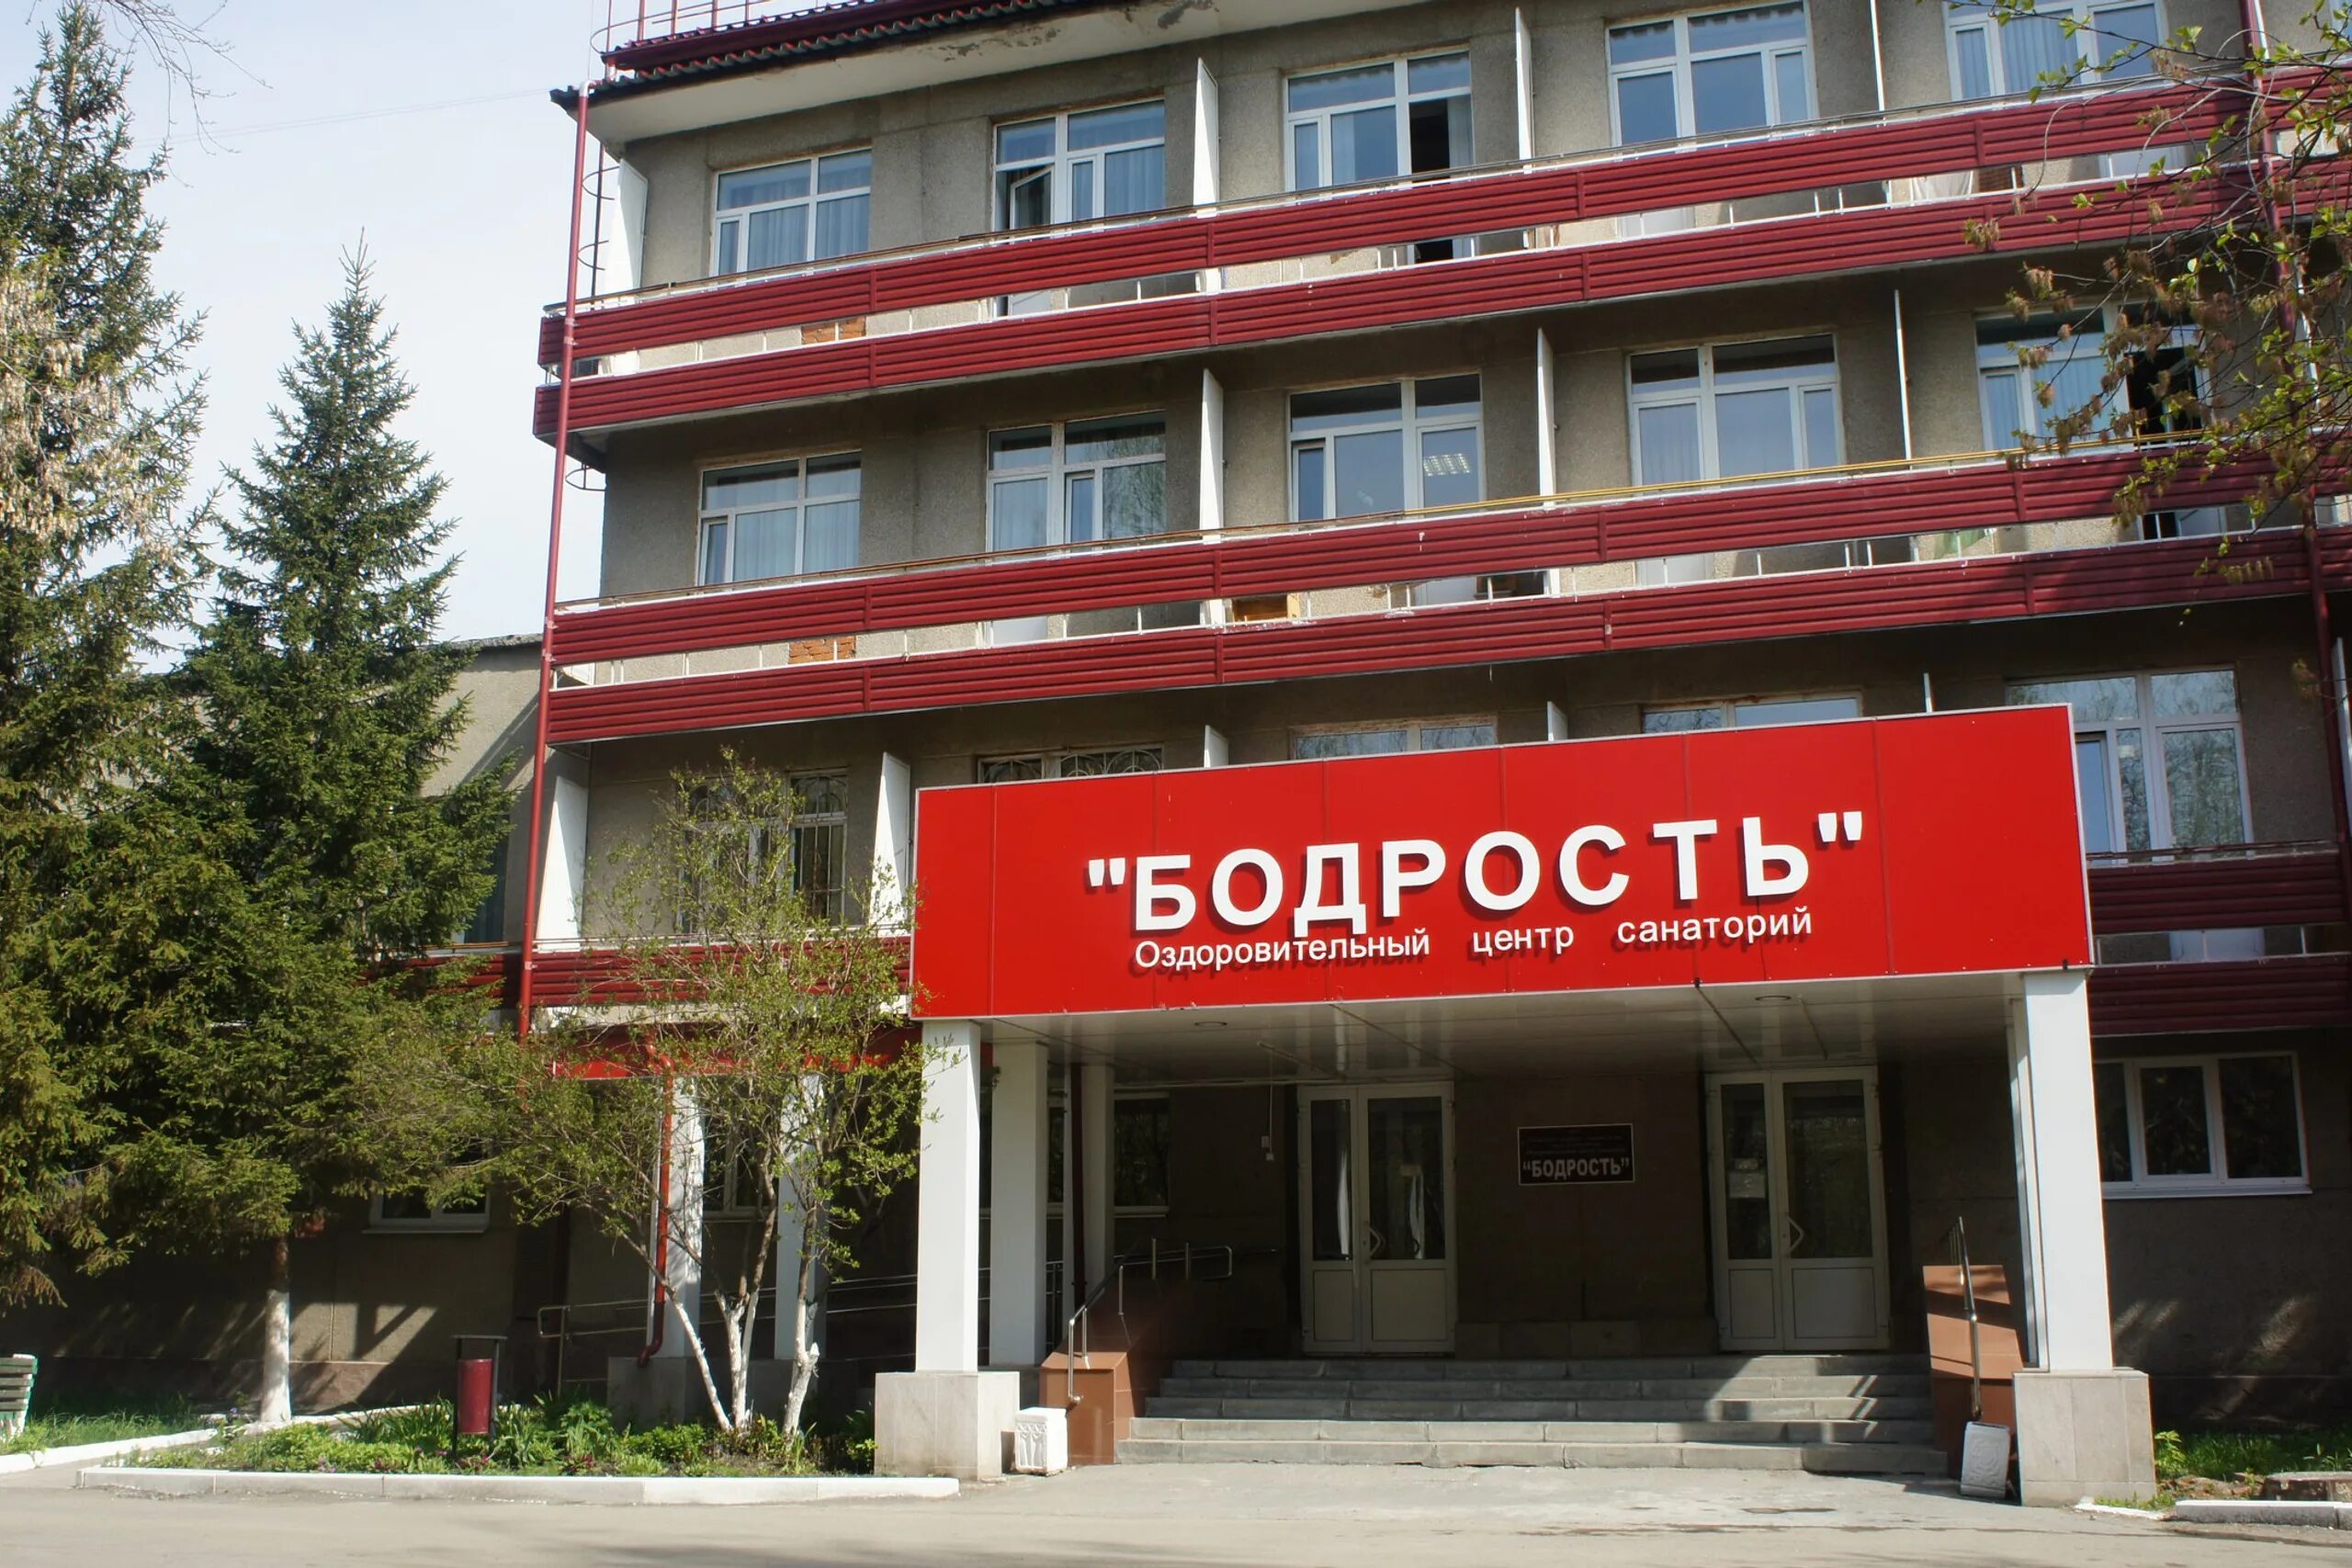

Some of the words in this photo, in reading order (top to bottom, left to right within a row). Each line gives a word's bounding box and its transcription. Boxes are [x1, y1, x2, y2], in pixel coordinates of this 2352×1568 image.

[1088, 812, 1863, 938] "БОДРОСТЬ"
[1136, 928, 1430, 971] Оздоровительный
[1473, 926, 1575, 957] центр
[1617, 906, 1813, 944] санаторий
